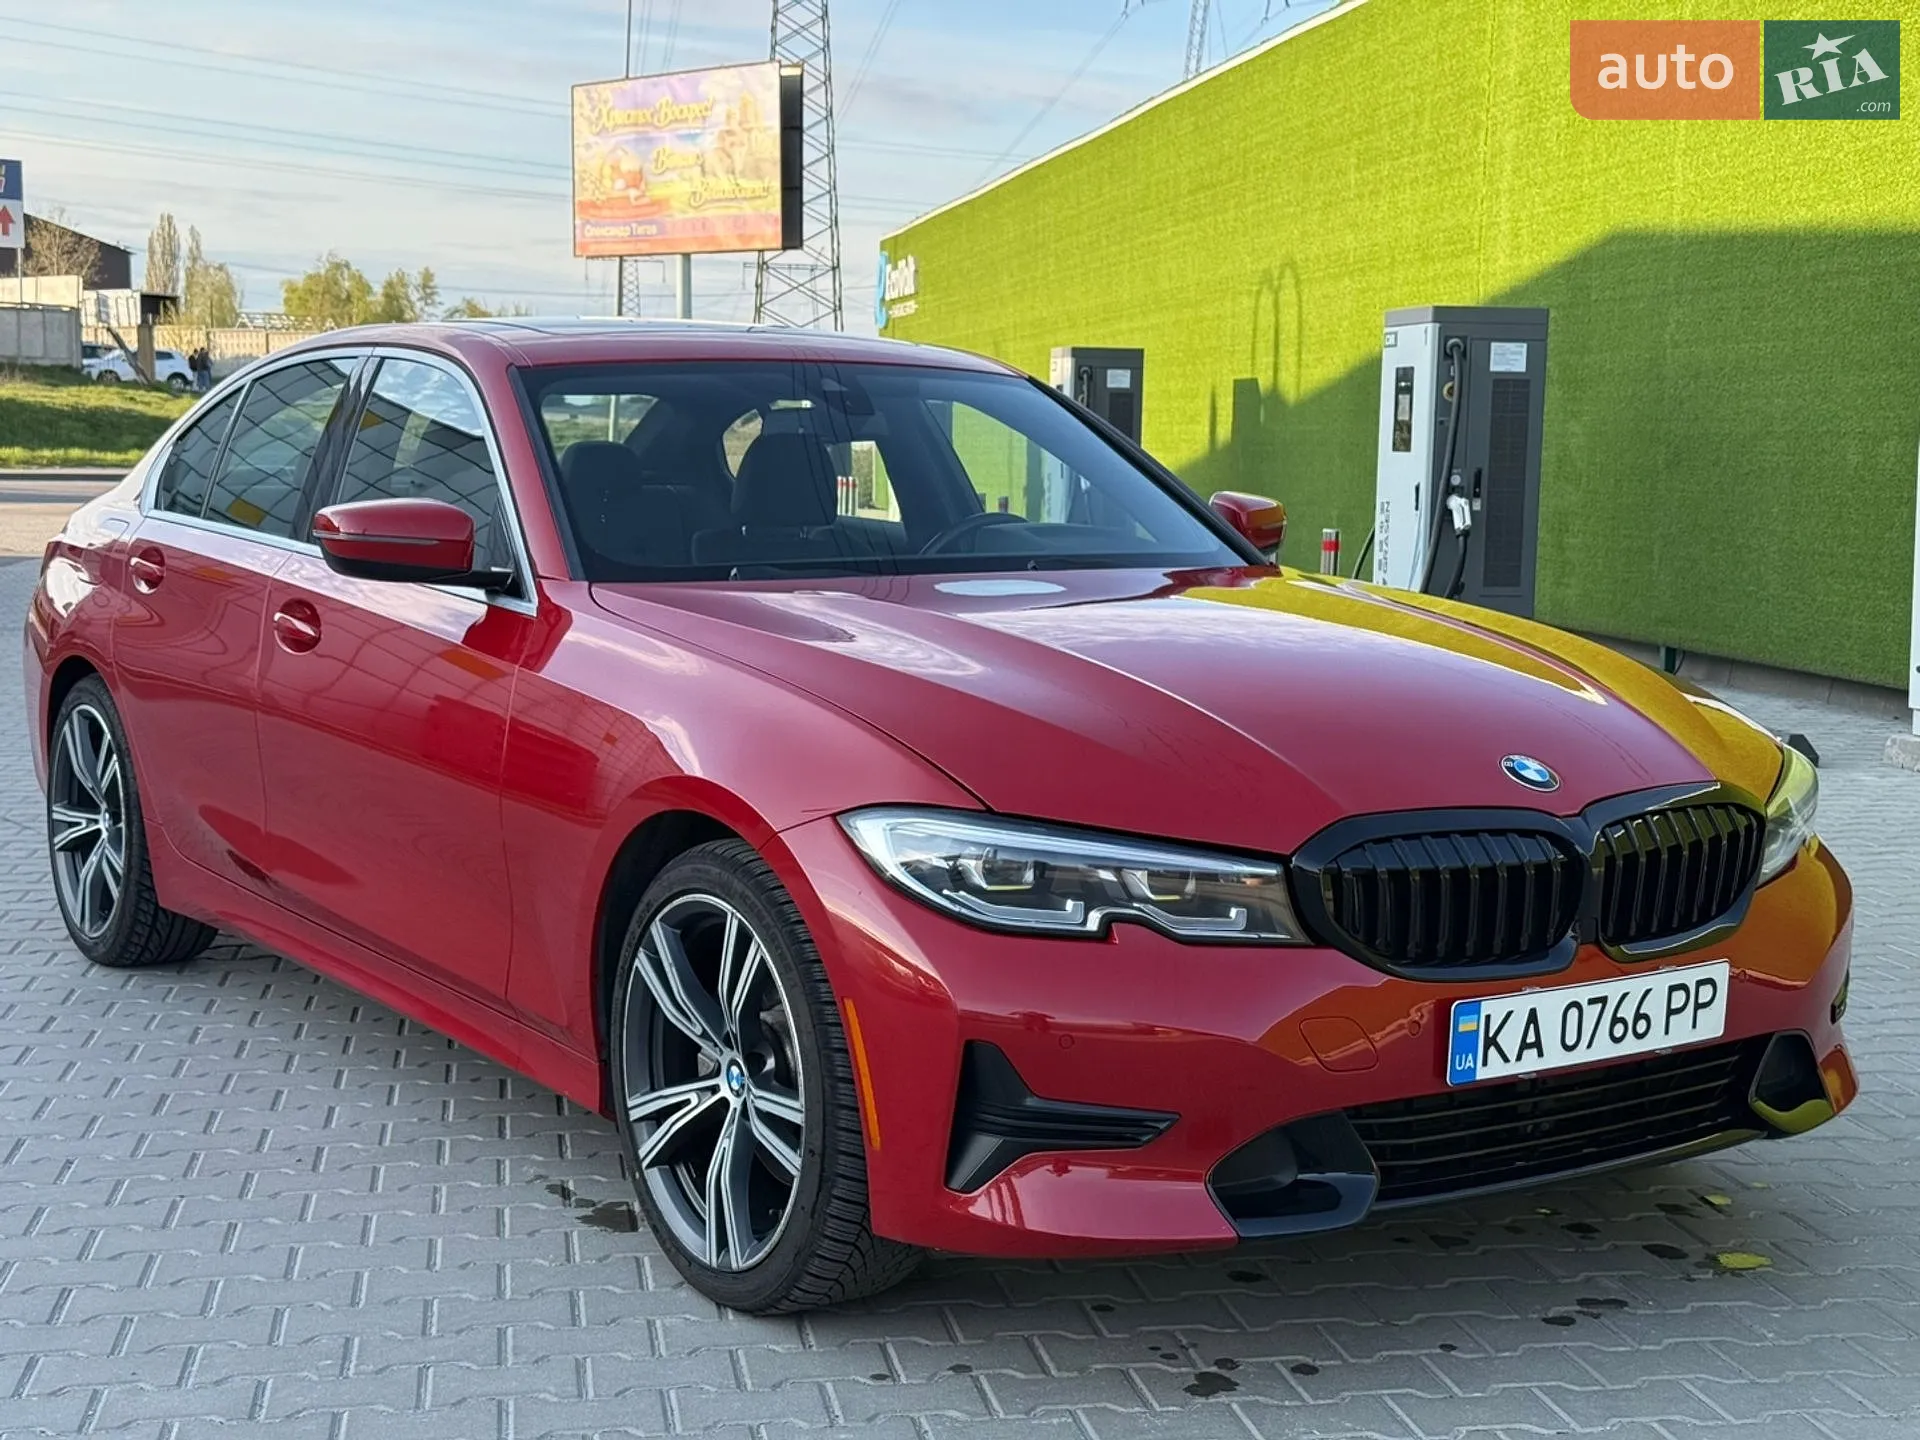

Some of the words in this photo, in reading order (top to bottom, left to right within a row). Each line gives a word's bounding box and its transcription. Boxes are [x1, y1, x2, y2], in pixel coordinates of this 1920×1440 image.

[1481, 1007, 1544, 1067] KA
[1559, 988, 1653, 1053] 0766
[1663, 977, 1718, 1036] PP
[1456, 1052, 1475, 1071] UA
